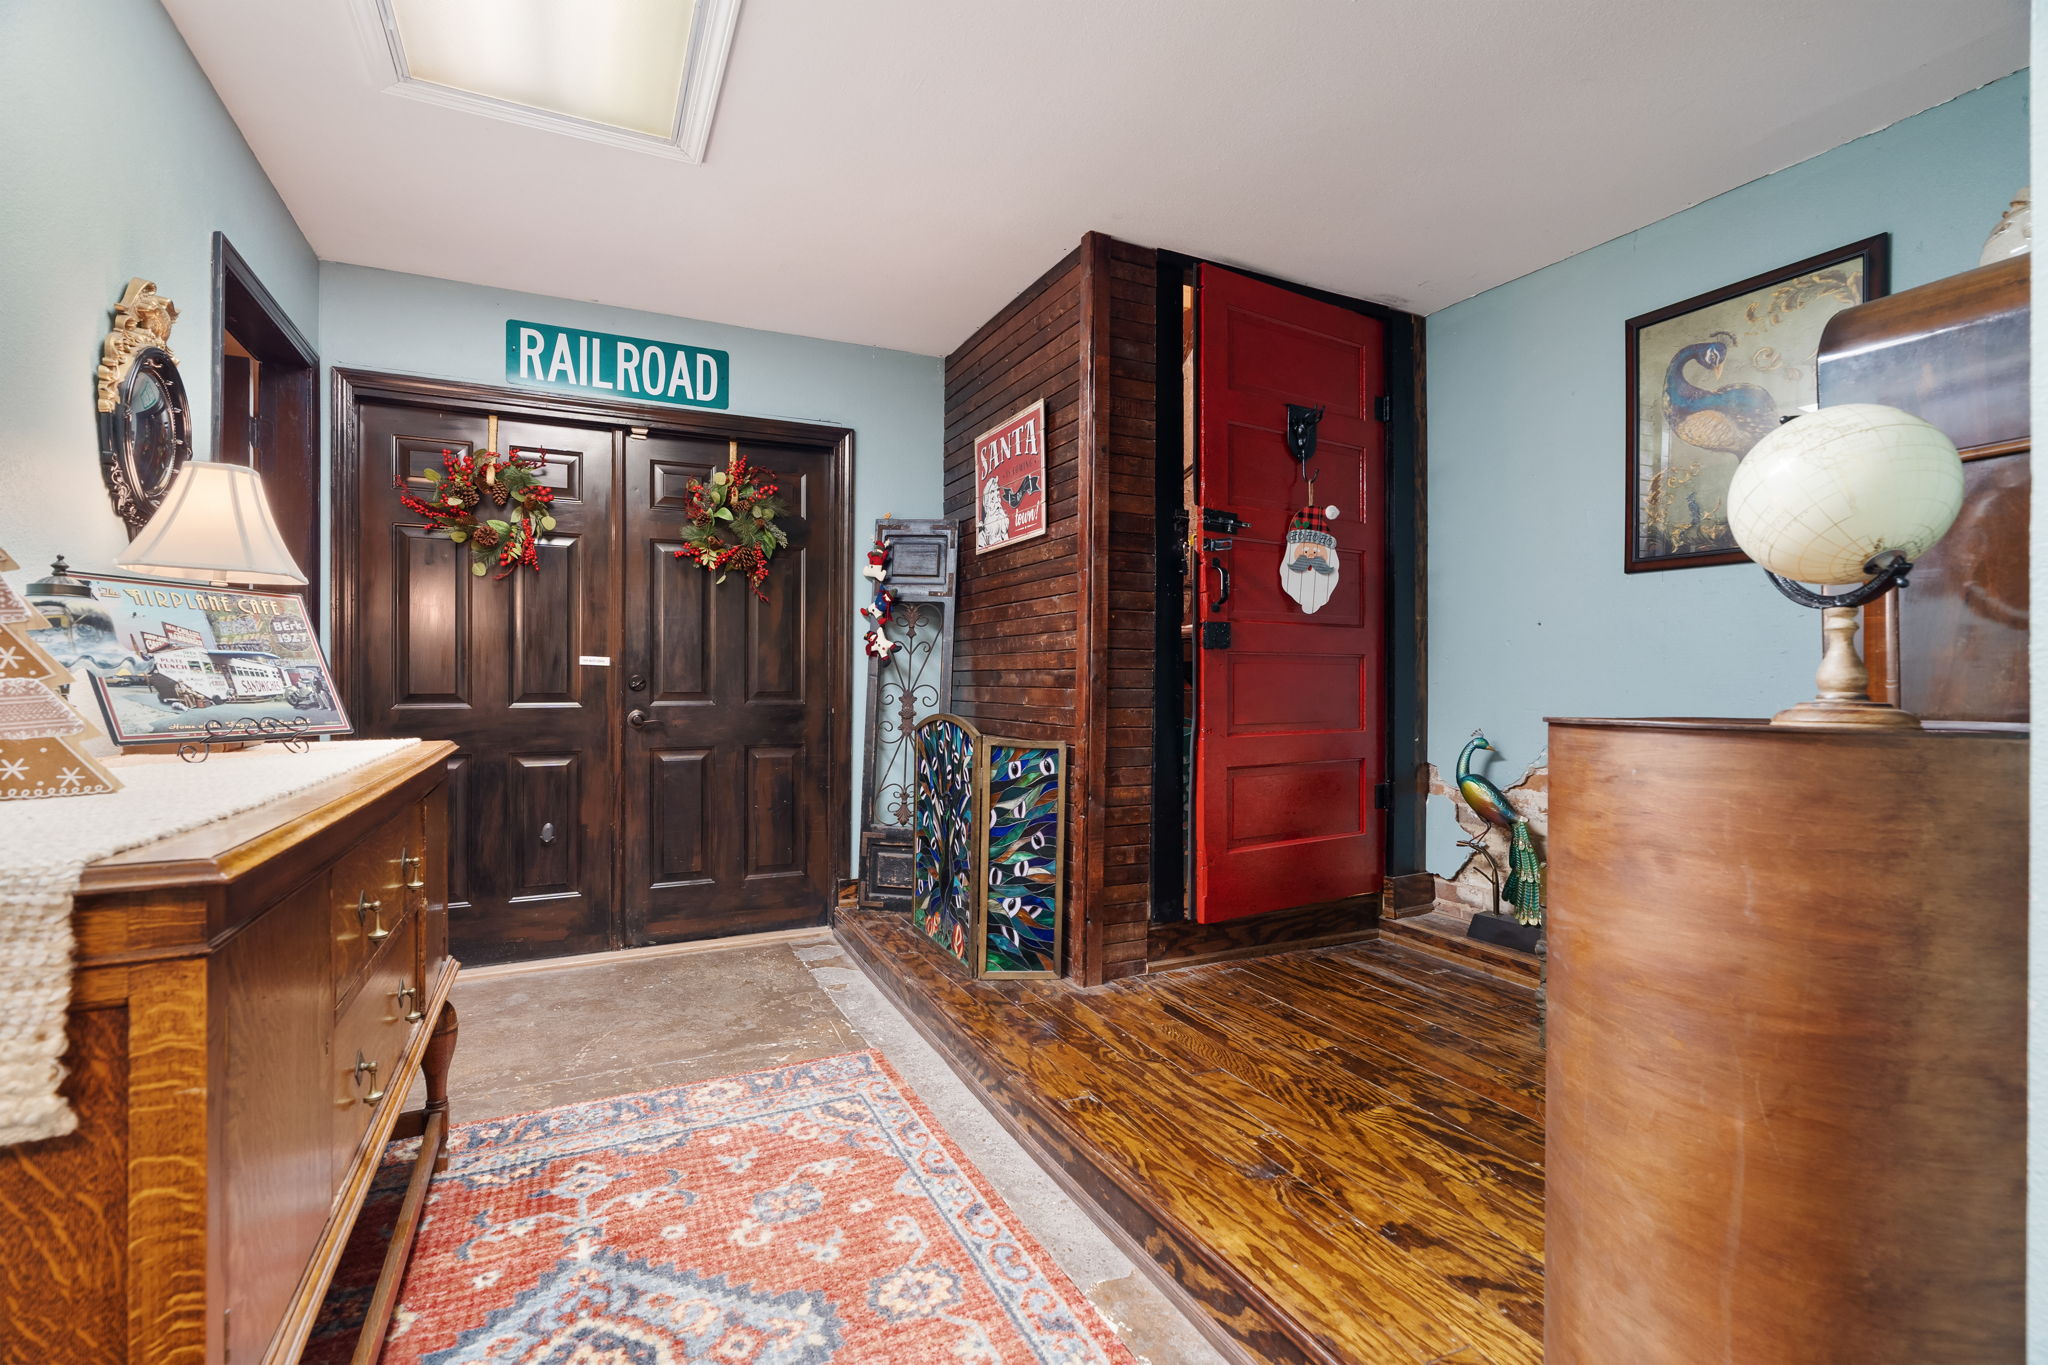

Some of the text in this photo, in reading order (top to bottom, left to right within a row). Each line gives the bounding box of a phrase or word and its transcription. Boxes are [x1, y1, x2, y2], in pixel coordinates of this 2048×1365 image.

[520, 327, 718, 402] RAILROAD
[980, 417, 1039, 481] SANTA
[1015, 500, 1040, 527] town!
[123, 588, 280, 616] AIRPLANE CAFE
[277, 632, 307, 644] 1927
[241, 680, 280, 693] SANDWICHES
